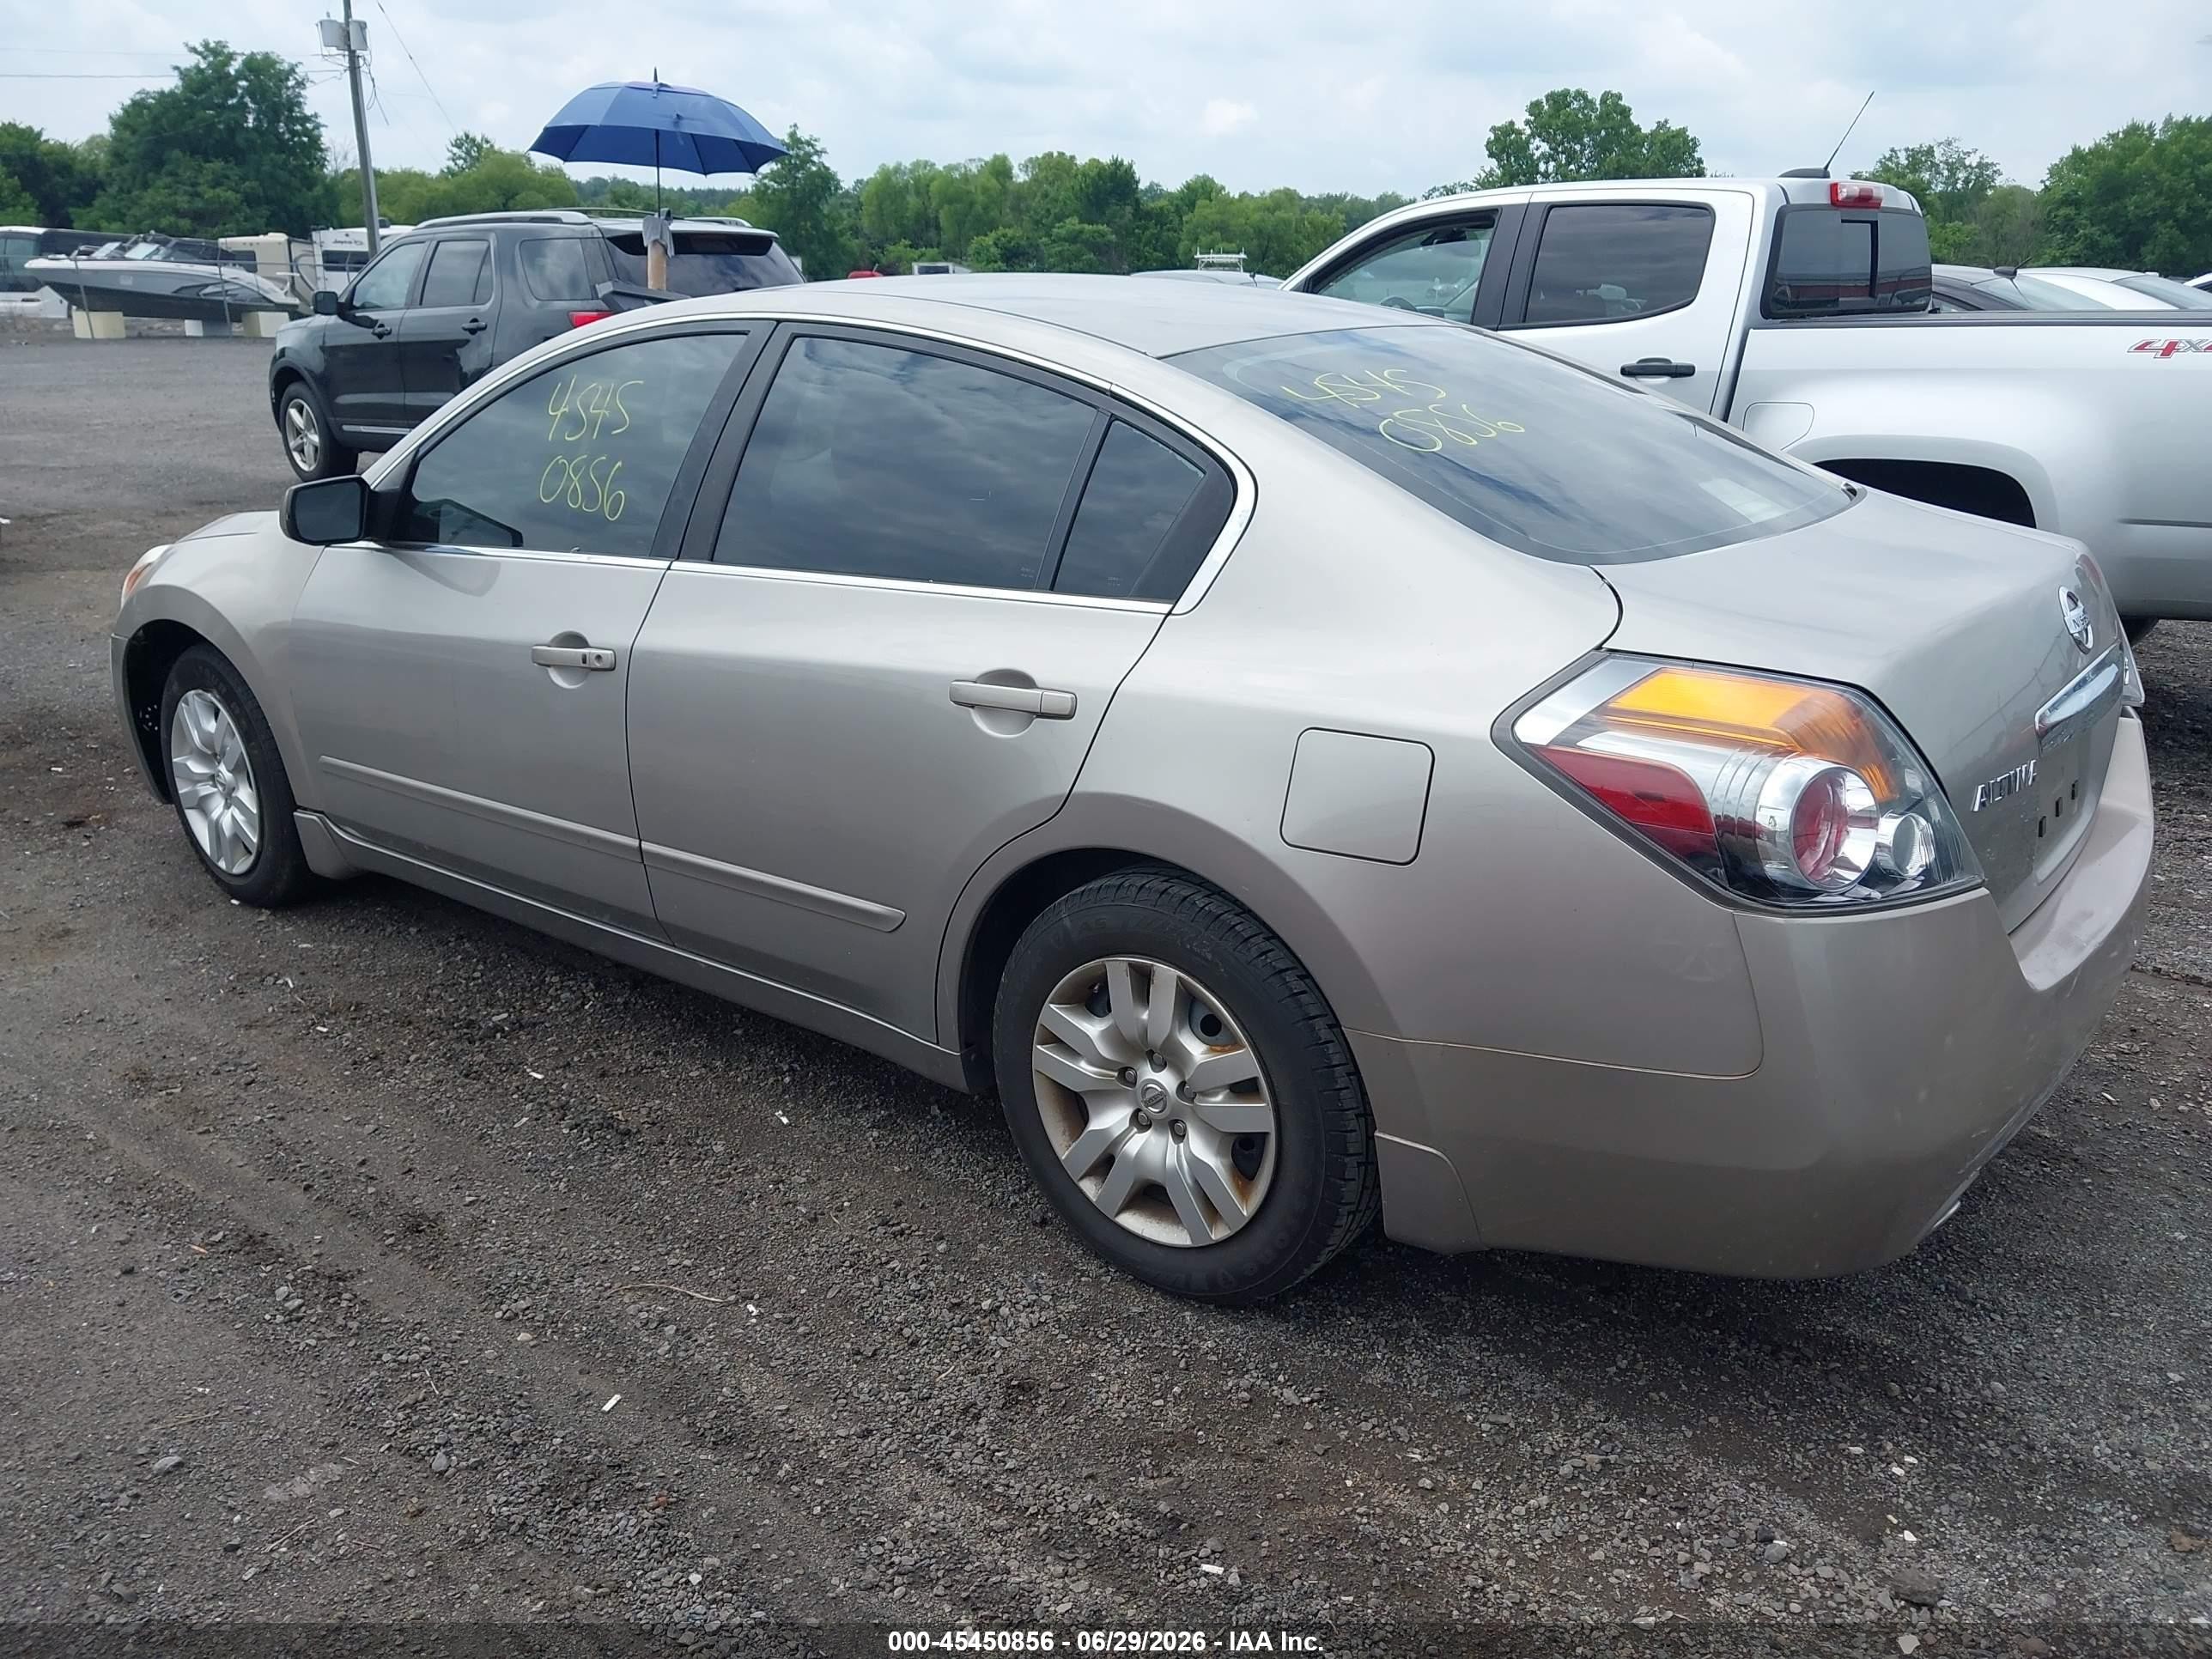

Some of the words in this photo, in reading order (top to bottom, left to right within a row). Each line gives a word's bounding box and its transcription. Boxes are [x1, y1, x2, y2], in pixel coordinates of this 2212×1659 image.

[548, 374, 644, 441] 4545
[1280, 368, 1447, 409] 4545
[1378, 404, 1526, 453] 0856
[539, 454, 625, 521] 0856
